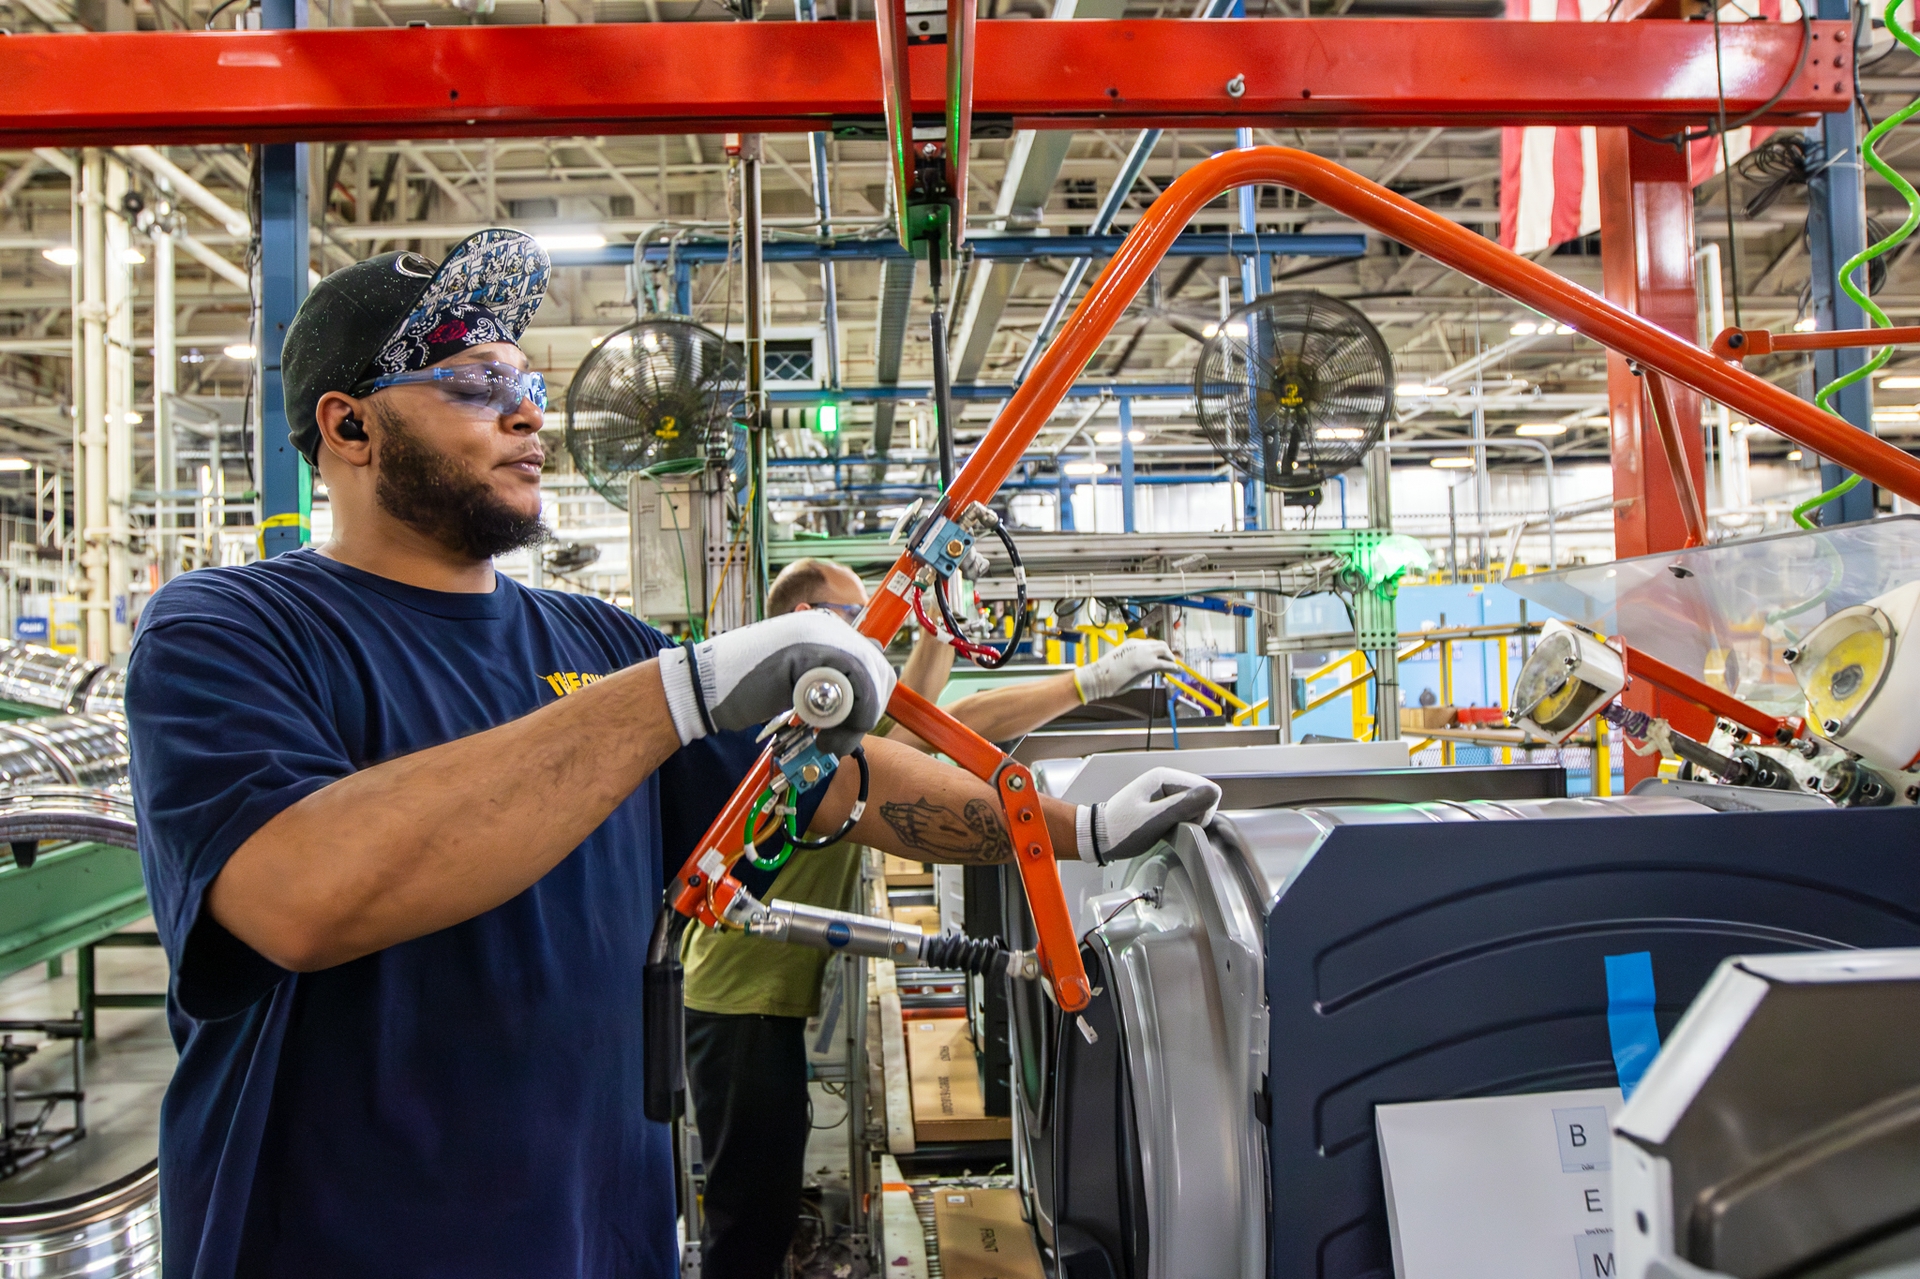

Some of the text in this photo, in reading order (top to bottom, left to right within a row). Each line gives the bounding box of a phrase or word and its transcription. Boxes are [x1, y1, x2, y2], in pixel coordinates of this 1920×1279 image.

[1569, 1123, 1587, 1147] B
[1584, 1188, 1604, 1213] E
[1593, 1252, 1617, 1278] M
